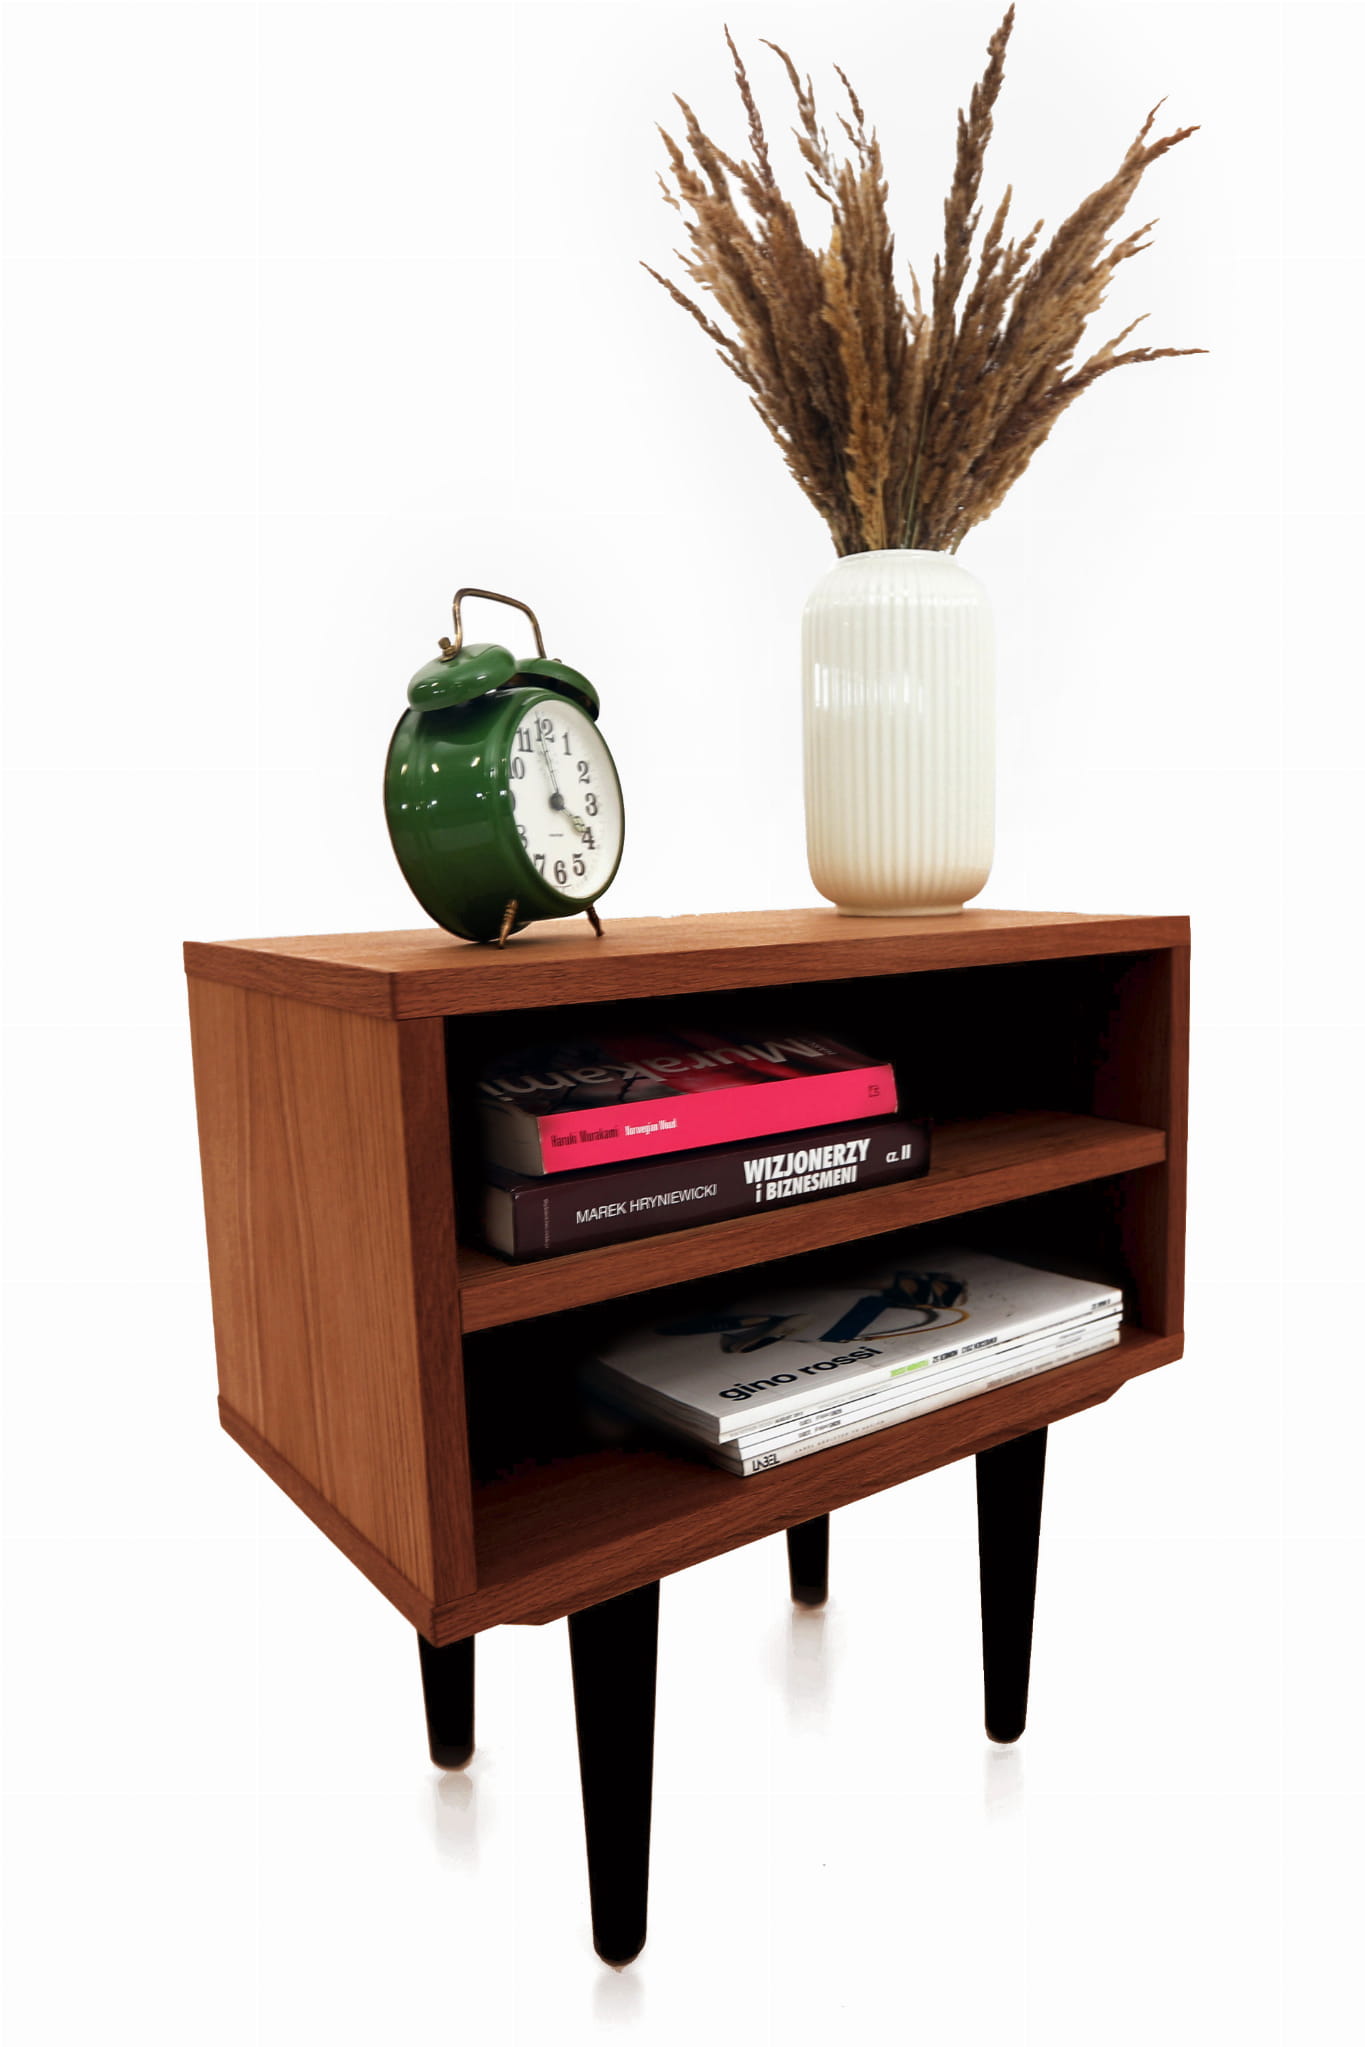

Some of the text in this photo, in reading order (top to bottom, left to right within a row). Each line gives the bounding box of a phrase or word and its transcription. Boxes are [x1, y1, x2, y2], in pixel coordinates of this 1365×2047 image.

[516, 727, 533, 753] 11
[534, 718, 555, 743] 12
[562, 732, 572, 756] 1
[577, 760, 590, 784] 2
[585, 793, 598, 816] 3
[581, 827, 596, 850] 4
[534, 854, 546, 878] 7
[554, 860, 567, 885] 6
[572, 854, 586, 876] 5
[478, 1038, 823, 1102] Murakami
[624, 1121, 658, 1136] Norwegian
[743, 1138, 871, 1185] WIZJONERZY
[901, 1143, 912, 1161] II
[755, 1165, 858, 1203] i BIZNESMENI
[576, 1201, 627, 1225] MAREK
[629, 1183, 717, 1213] HRYNIEWICKI
[719, 1369, 799, 1402] gino
[798, 1346, 884, 1376] rossi
